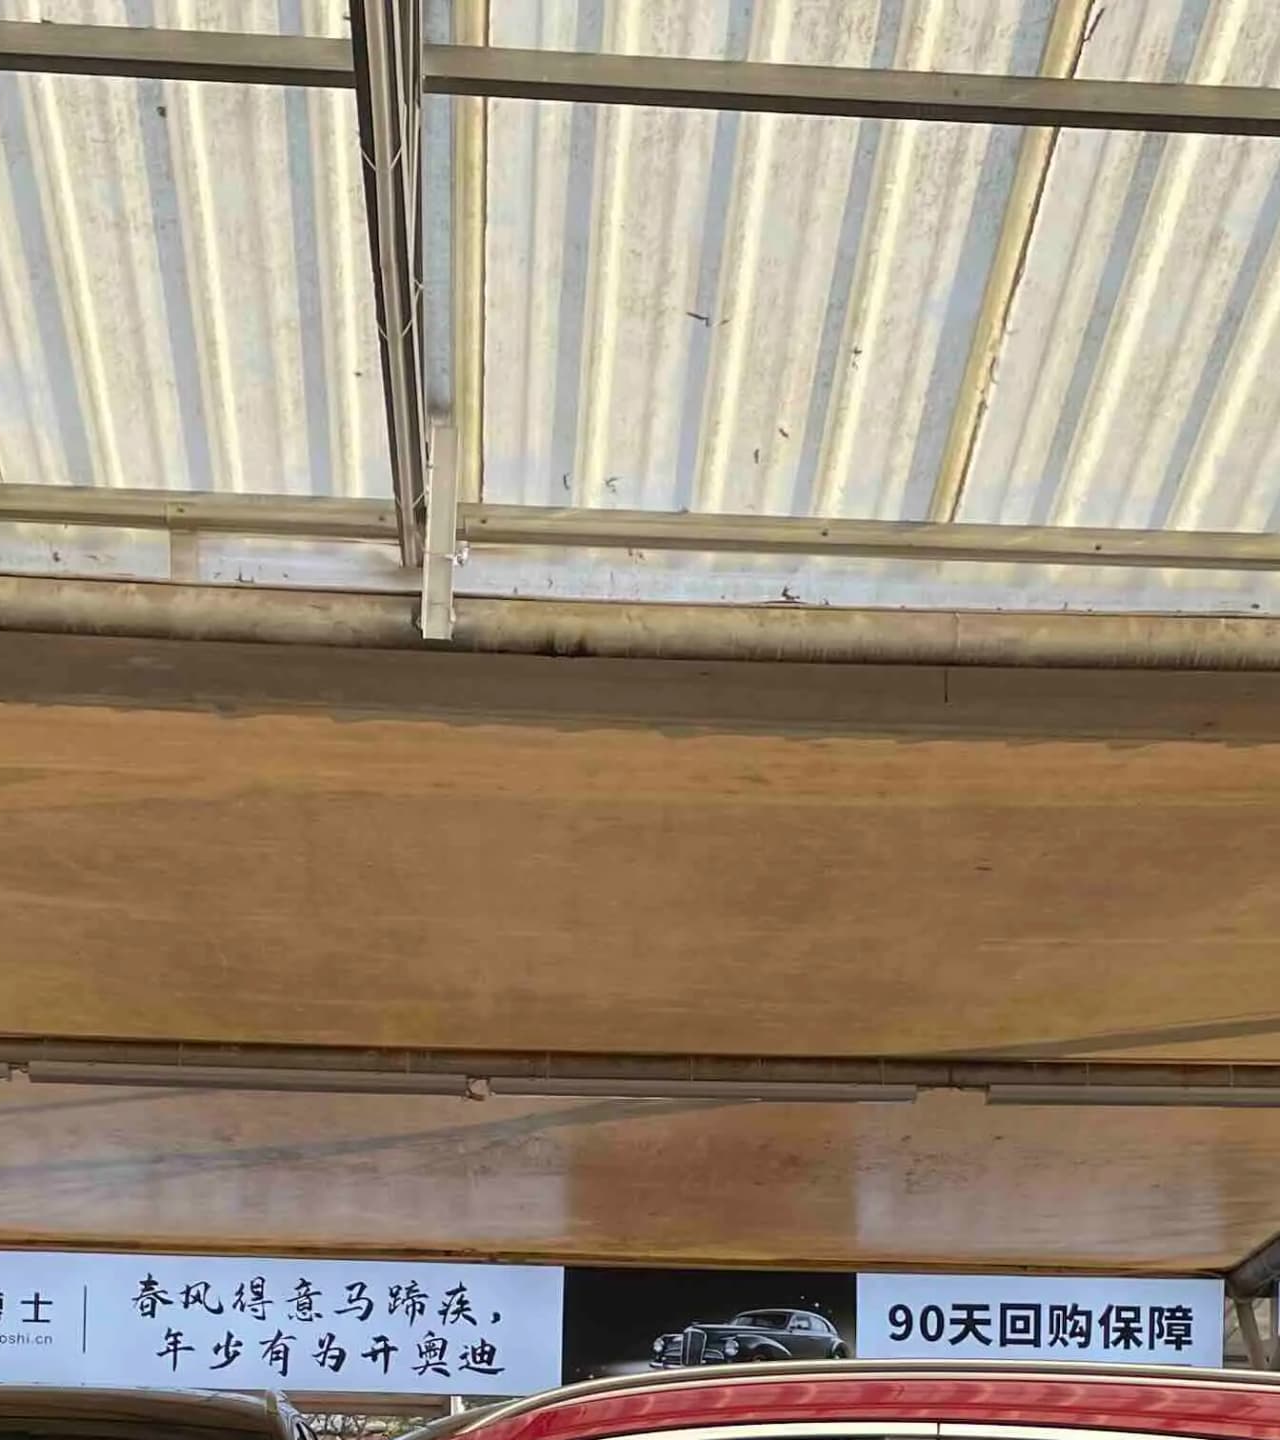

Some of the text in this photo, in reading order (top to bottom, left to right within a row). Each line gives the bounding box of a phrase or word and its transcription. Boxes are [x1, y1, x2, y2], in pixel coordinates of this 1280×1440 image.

[888, 1302, 1193, 1351] 90天回购保障
[156, 1328, 505, 1377] 年少有为开奥迪
